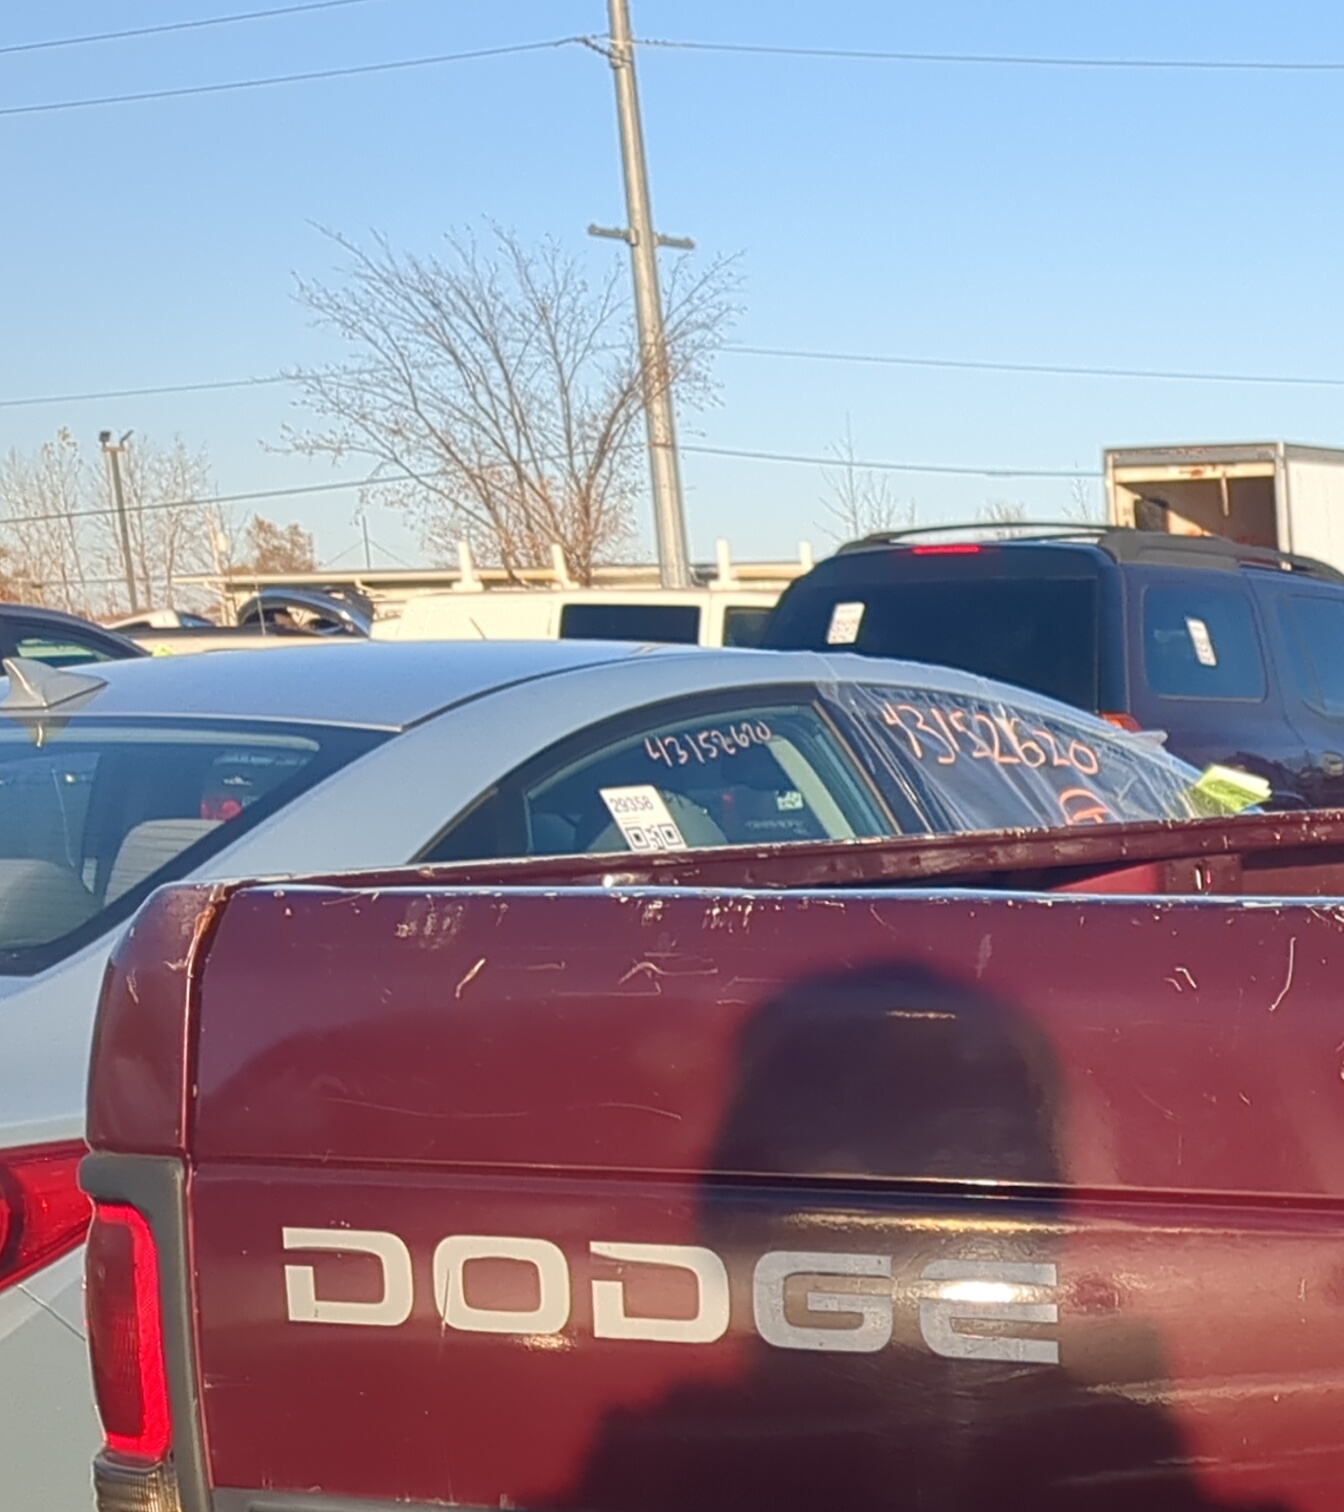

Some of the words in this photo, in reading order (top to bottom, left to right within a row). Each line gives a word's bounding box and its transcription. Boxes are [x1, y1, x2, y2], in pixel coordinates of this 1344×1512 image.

[882, 701, 1100, 775] 43152620
[609, 794, 654, 813] 29358
[281, 1226, 1061, 1365] DODGE
